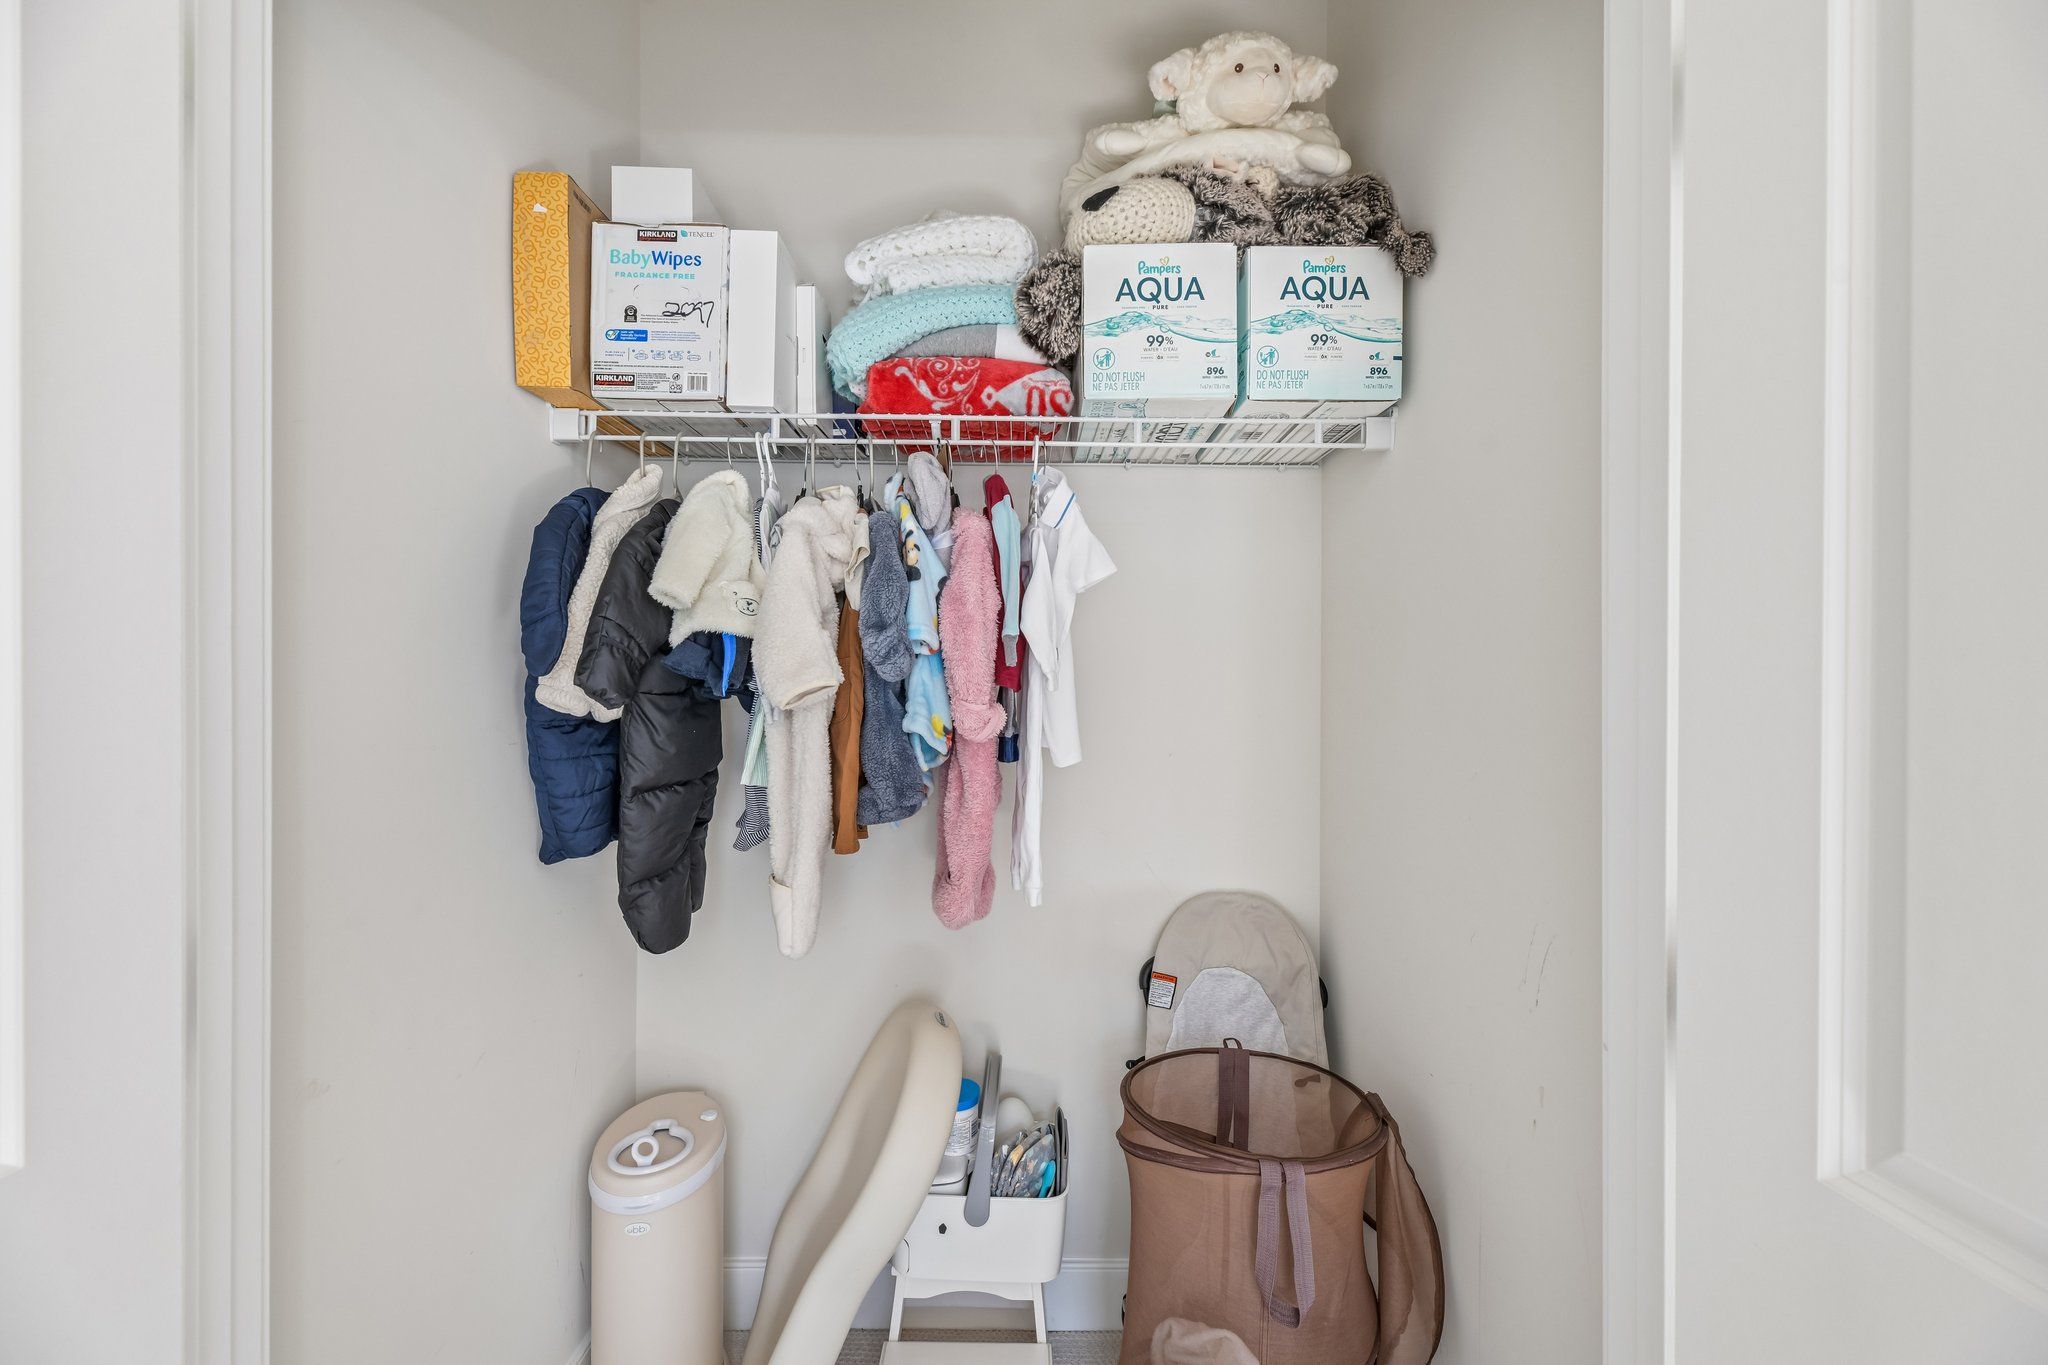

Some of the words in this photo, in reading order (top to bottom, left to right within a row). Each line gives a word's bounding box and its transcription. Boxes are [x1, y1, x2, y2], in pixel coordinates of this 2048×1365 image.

[639, 230, 676, 238] KIRKLAND
[1137, 260, 1181, 276] Pampers
[1303, 260, 1347, 275] Pampers
[615, 271, 670, 279] FRAGRANCE
[1115, 276, 1206, 304] AQUA
[1279, 275, 1370, 303] AQUA
[1146, 334, 1174, 347] 99%
[1310, 333, 1338, 346] 99%
[1206, 366, 1225, 375] 896
[1256, 370, 1267, 380] DO
[1269, 370, 1284, 380] NOT
[1286, 370, 1309, 380] FLUSH
[1369, 366, 1388, 375] 896
[595, 374, 634, 382] KIRKLAND
[1092, 372, 1104, 382] DO
[1106, 372, 1120, 382] NOT
[1122, 371, 1145, 382] FLUSH
[1092, 382, 1102, 391] NE
[1104, 382, 1118, 391] PAS
[1120, 382, 1140, 391] JETER
[1256, 381, 1266, 390] NE
[1268, 380, 1282, 389] PAS
[1283, 380, 1304, 389] JETER
